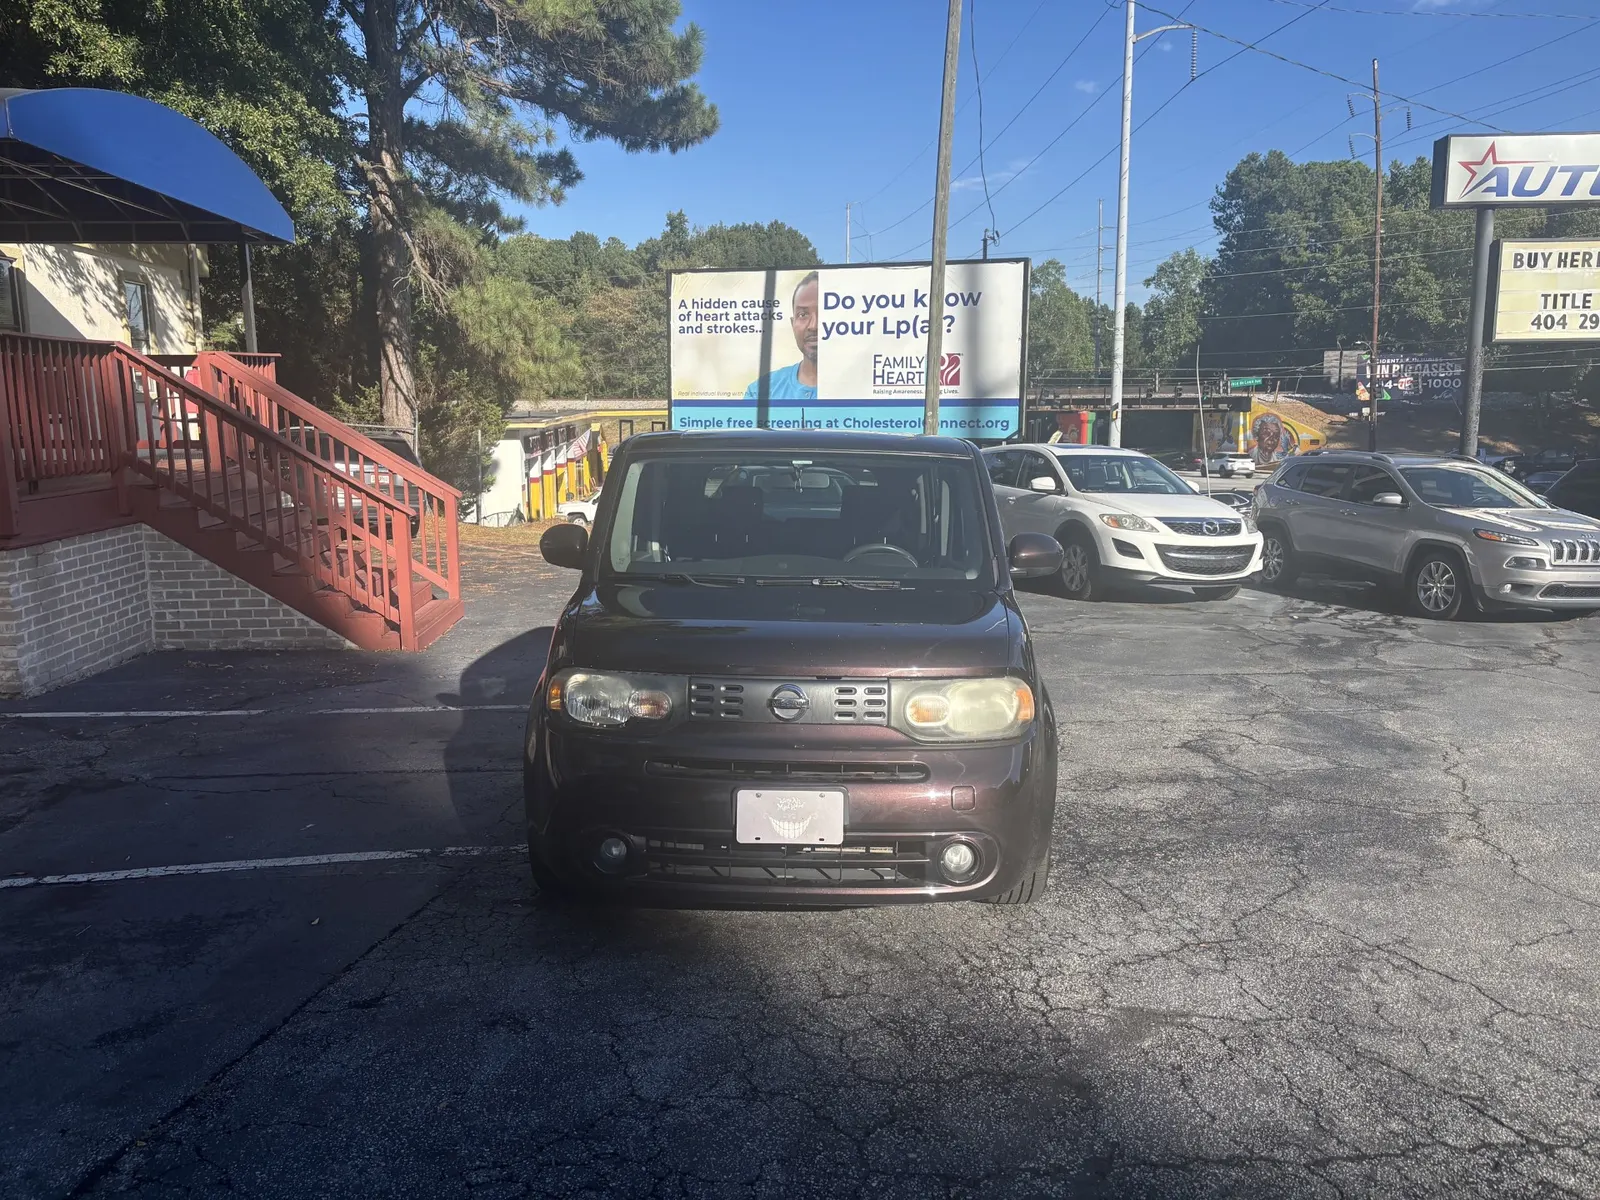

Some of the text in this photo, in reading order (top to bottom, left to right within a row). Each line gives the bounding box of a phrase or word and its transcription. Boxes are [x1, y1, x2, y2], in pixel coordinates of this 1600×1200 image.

[1513, 252, 1553, 269] BUY
[678, 298, 780, 309] A hidden cause
[823, 289, 982, 314] Do you kow
[1541, 293, 1592, 310] TITLE
[678, 310, 783, 321] of heart attacks
[1531, 313, 1600, 330] 404 29
[678, 322, 765, 334] and strokes...
[821, 315, 956, 340] your Lp(a?
[873, 354, 925, 369] FAMILY
[873, 369, 925, 385] HEART
[679, 416, 724, 429] Simple
[726, 417, 754, 428] free
[825, 418, 839, 428] at
[843, 417, 1010, 431] Cholesterolnnect.org
